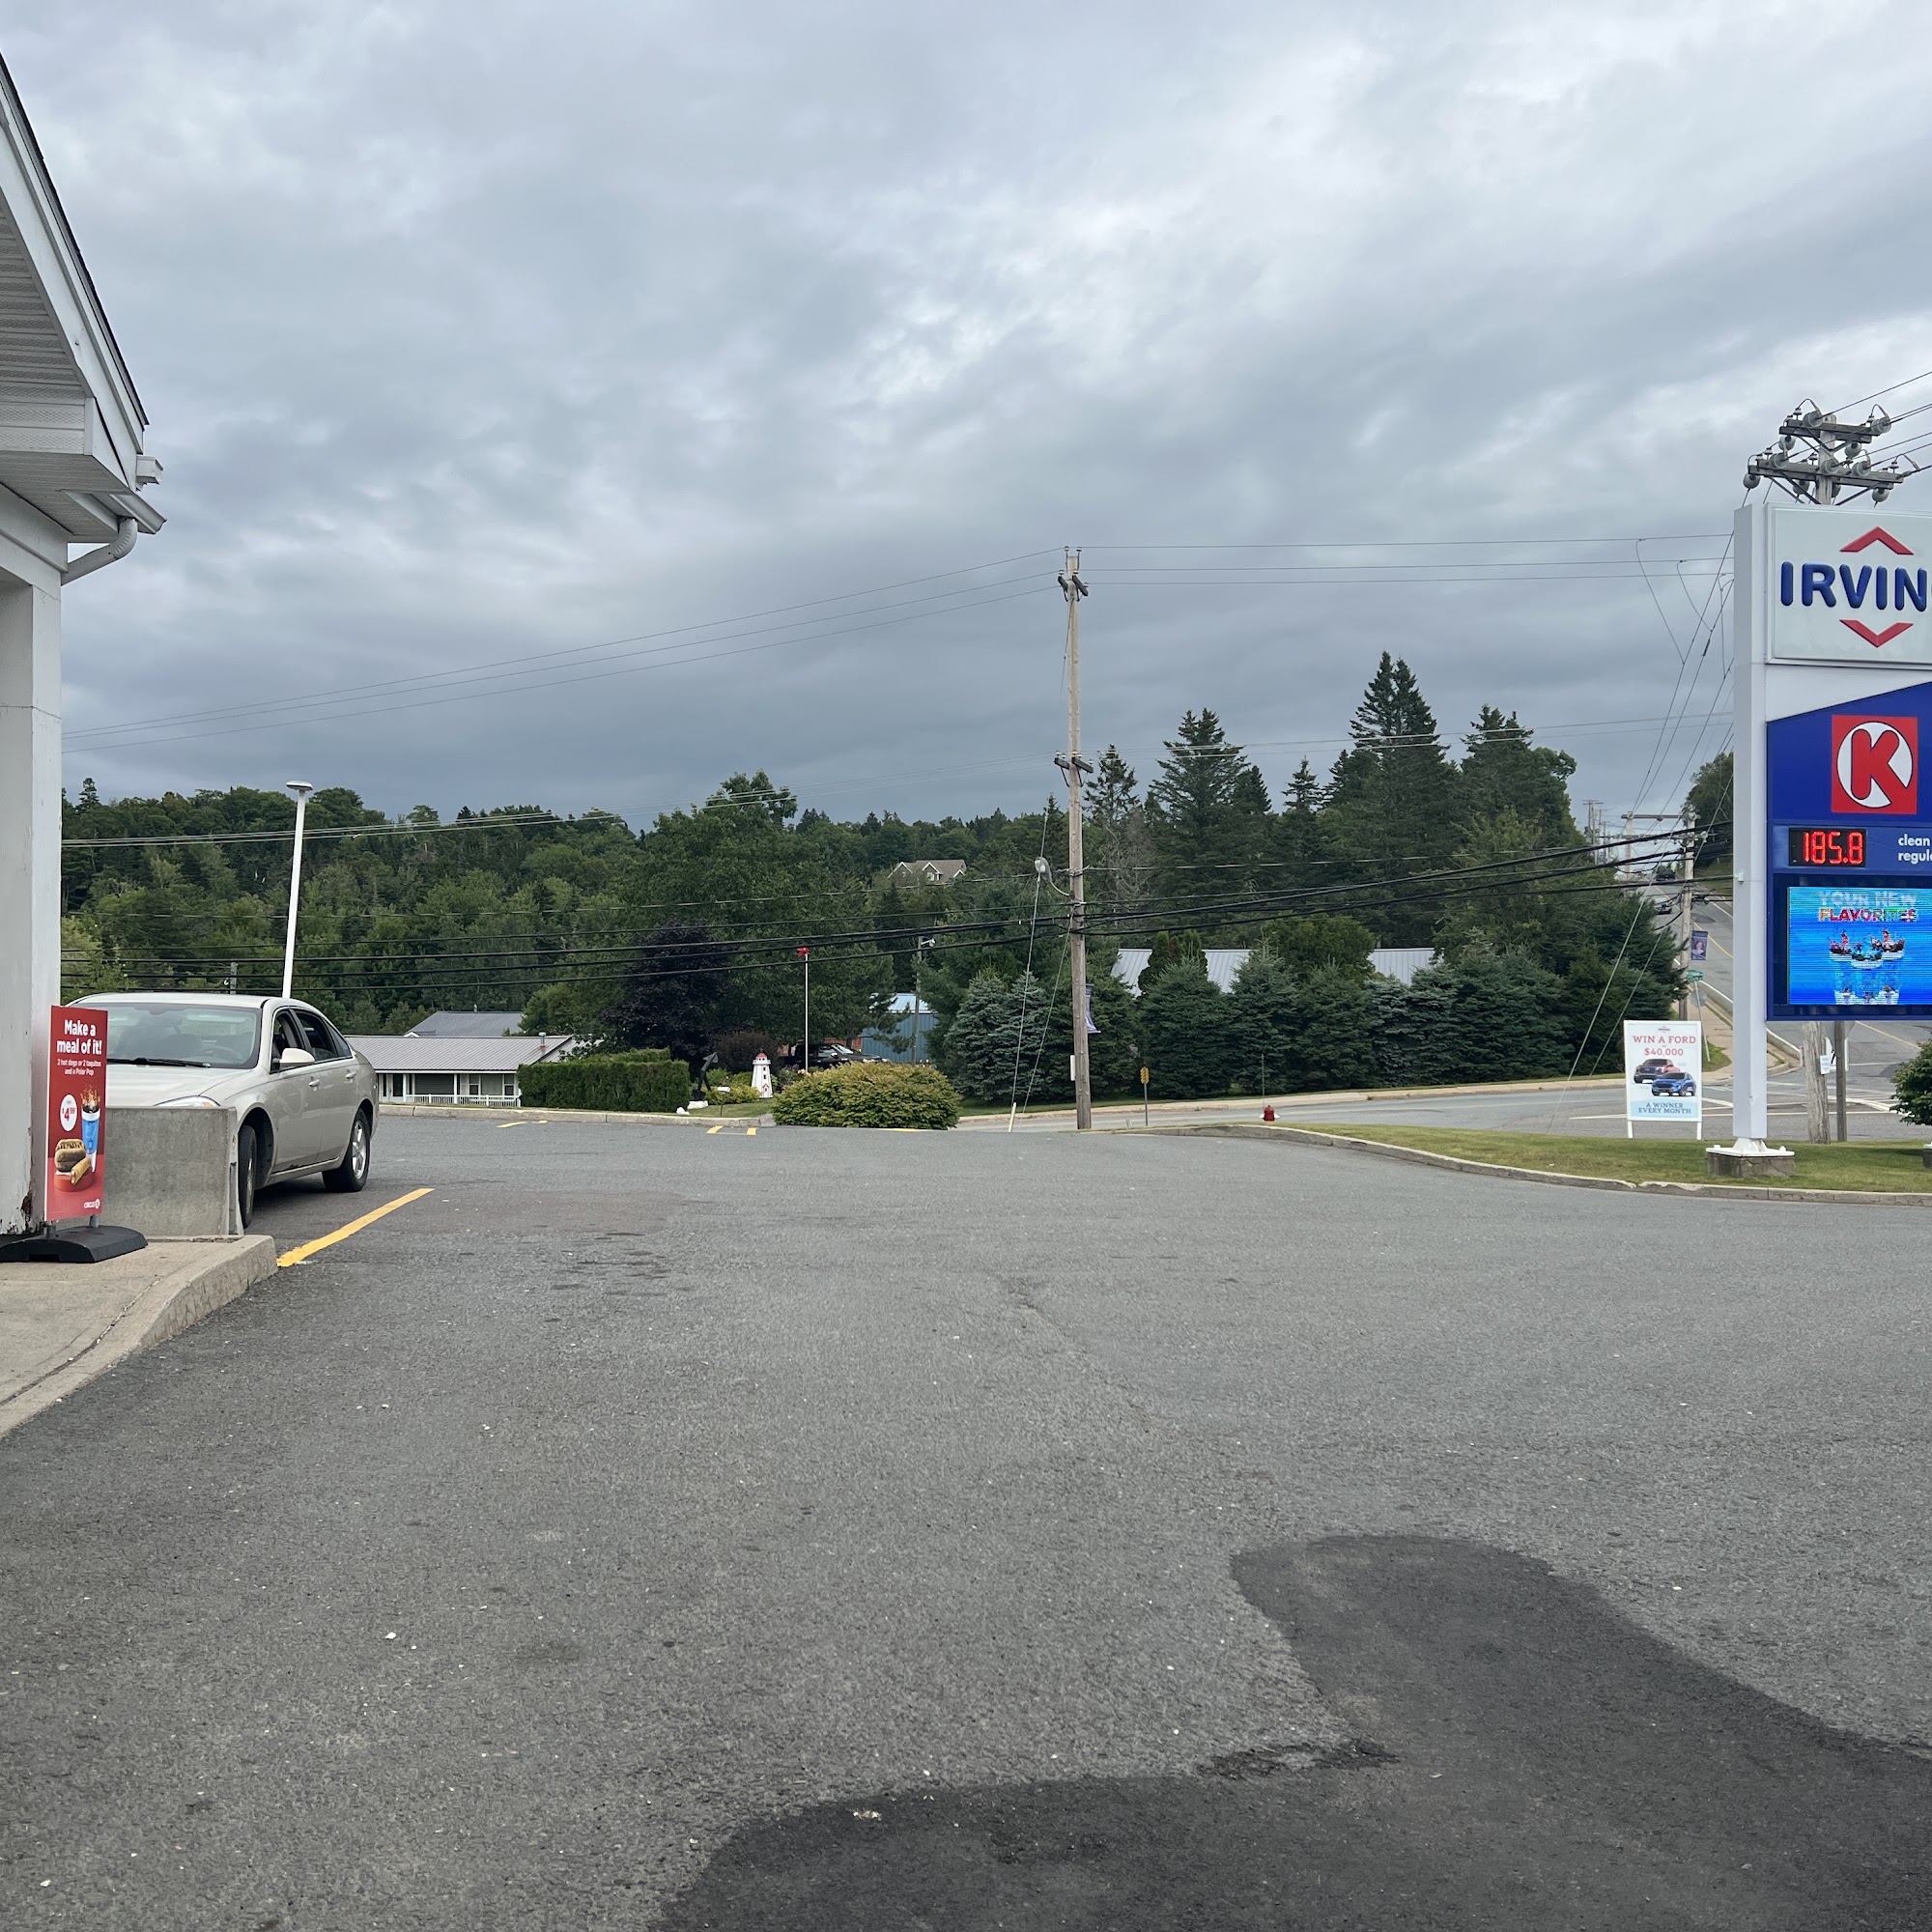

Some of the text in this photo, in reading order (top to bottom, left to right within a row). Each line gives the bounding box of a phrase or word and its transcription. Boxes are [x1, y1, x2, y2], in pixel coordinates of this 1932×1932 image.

[1780, 561, 1932, 612] IRVIN
[1804, 832, 1863, 864] 185.8
[1898, 834, 1930, 846] clean
[64, 1019, 96, 1037] Make a
[56, 1038, 102, 1055] meal of it!
[1668, 1036, 1696, 1044] FORD
[1644, 1047, 1684, 1057] $40,000
